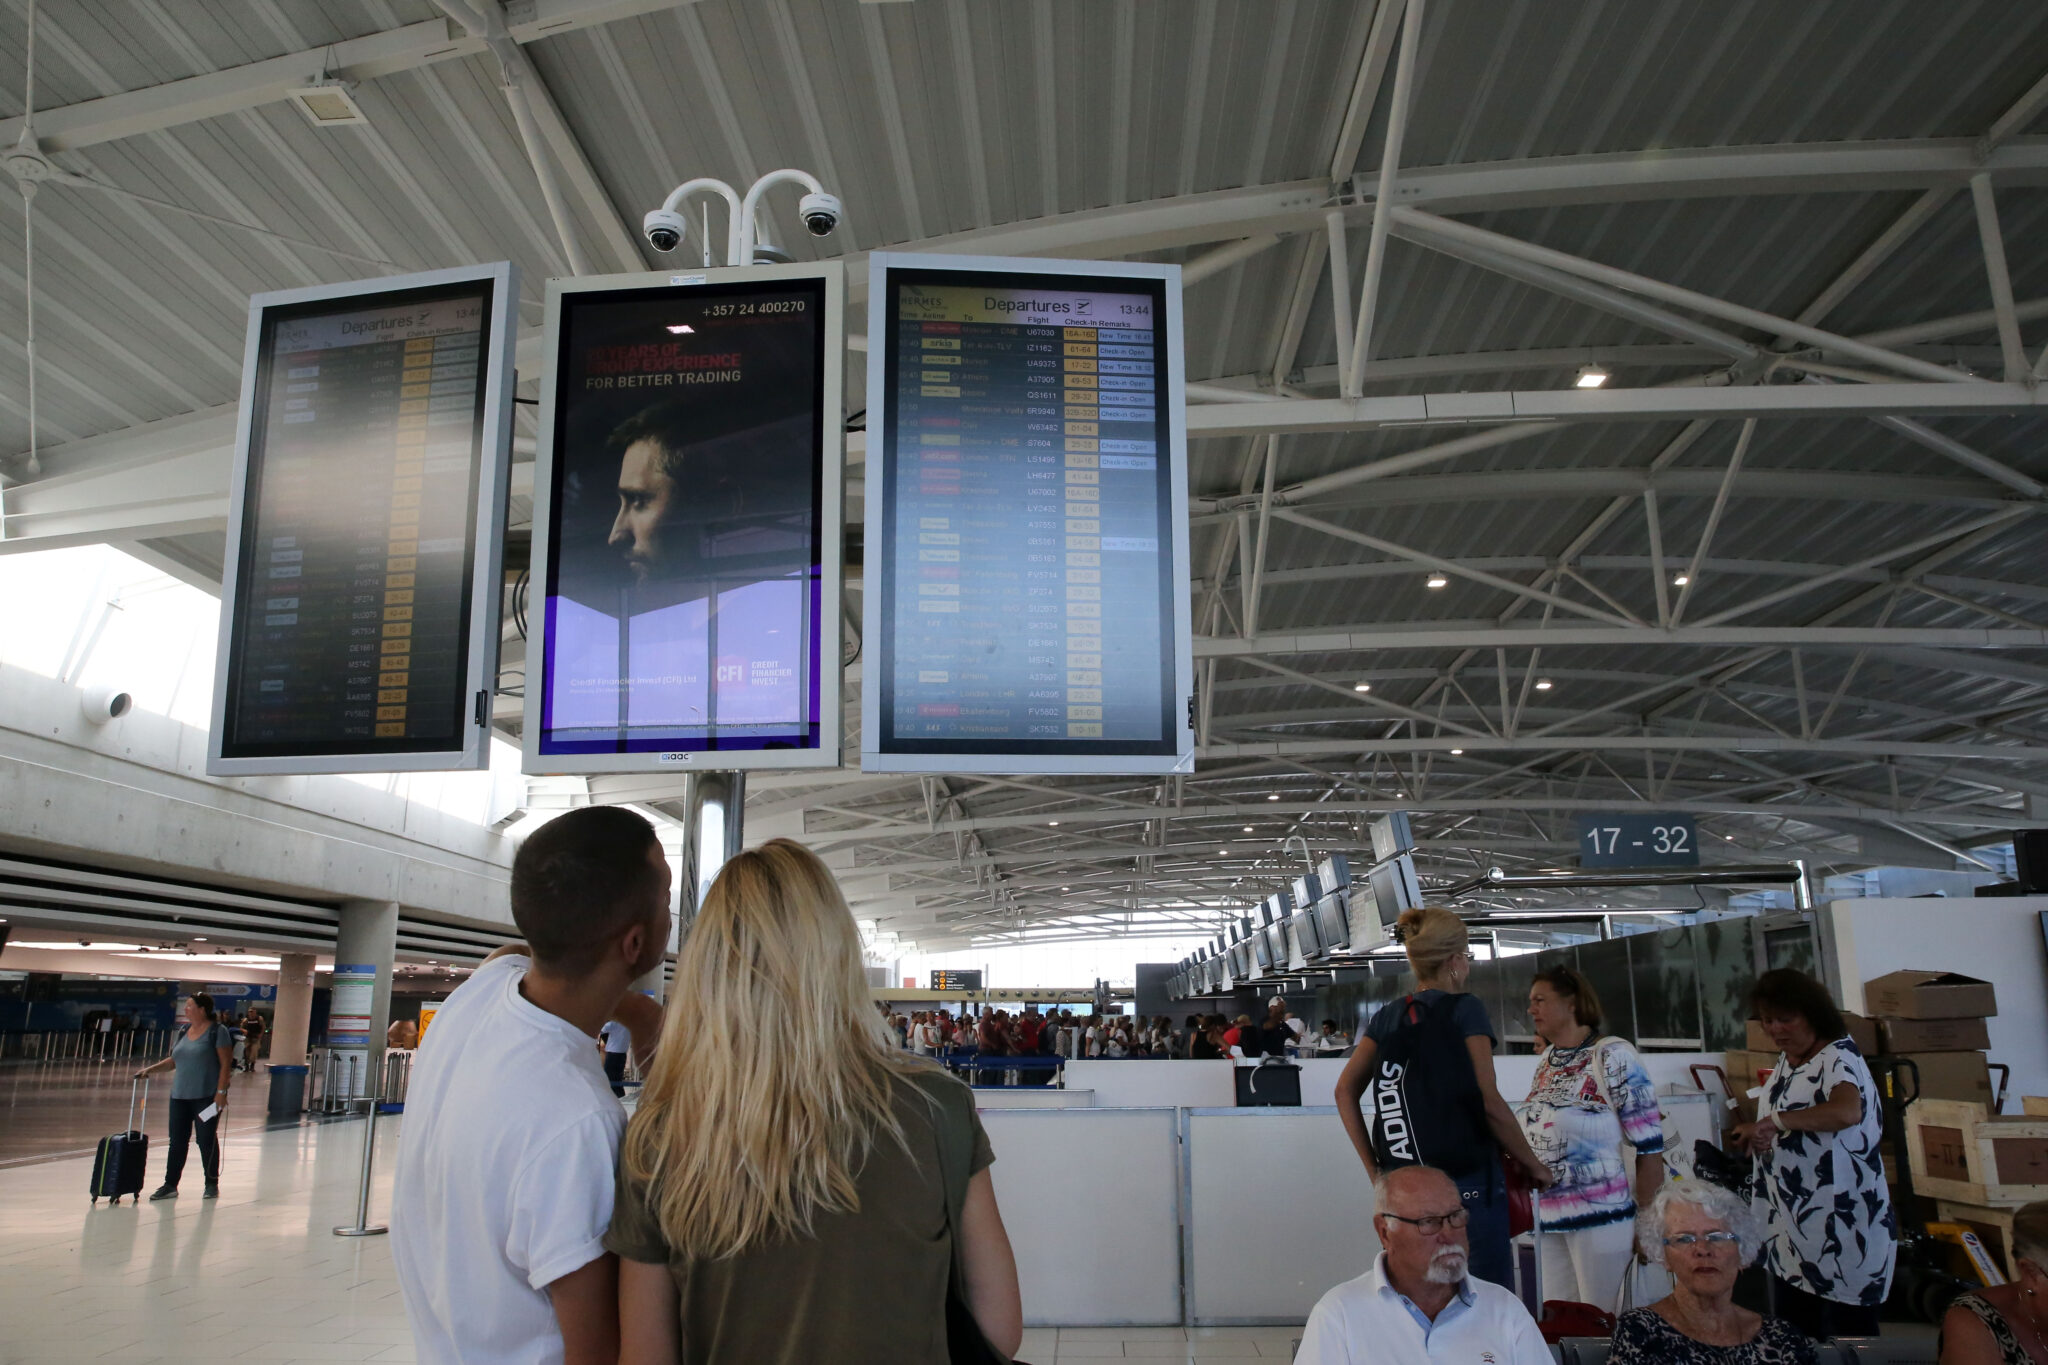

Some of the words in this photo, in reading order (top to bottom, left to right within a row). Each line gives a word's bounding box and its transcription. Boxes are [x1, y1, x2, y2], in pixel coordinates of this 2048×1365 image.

[702, 304, 735, 317] +357
[739, 303, 755, 315] 24
[758, 300, 806, 314] 400270
[984, 296, 1071, 314] Departures
[1119, 304, 1150, 315] 13:44
[341, 314, 413, 335] Departures
[1027, 316, 1050, 325] Flight
[1098, 319, 1131, 328] Remarks
[661, 343, 682, 356] OF
[644, 353, 742, 372] EXPERIENCE
[586, 375, 613, 390] FOR
[618, 373, 672, 388] BETTER
[676, 370, 742, 385] TRADING
[752, 660, 779, 668] CREDIT
[752, 668, 792, 677] FINANCIER
[716, 665, 743, 682] CFI
[752, 677, 778, 686] INVEST
[1586, 827, 1621, 854] 17
[1652, 825, 1691, 853] 32
[1377, 1060, 1414, 1160] ADIDAS
